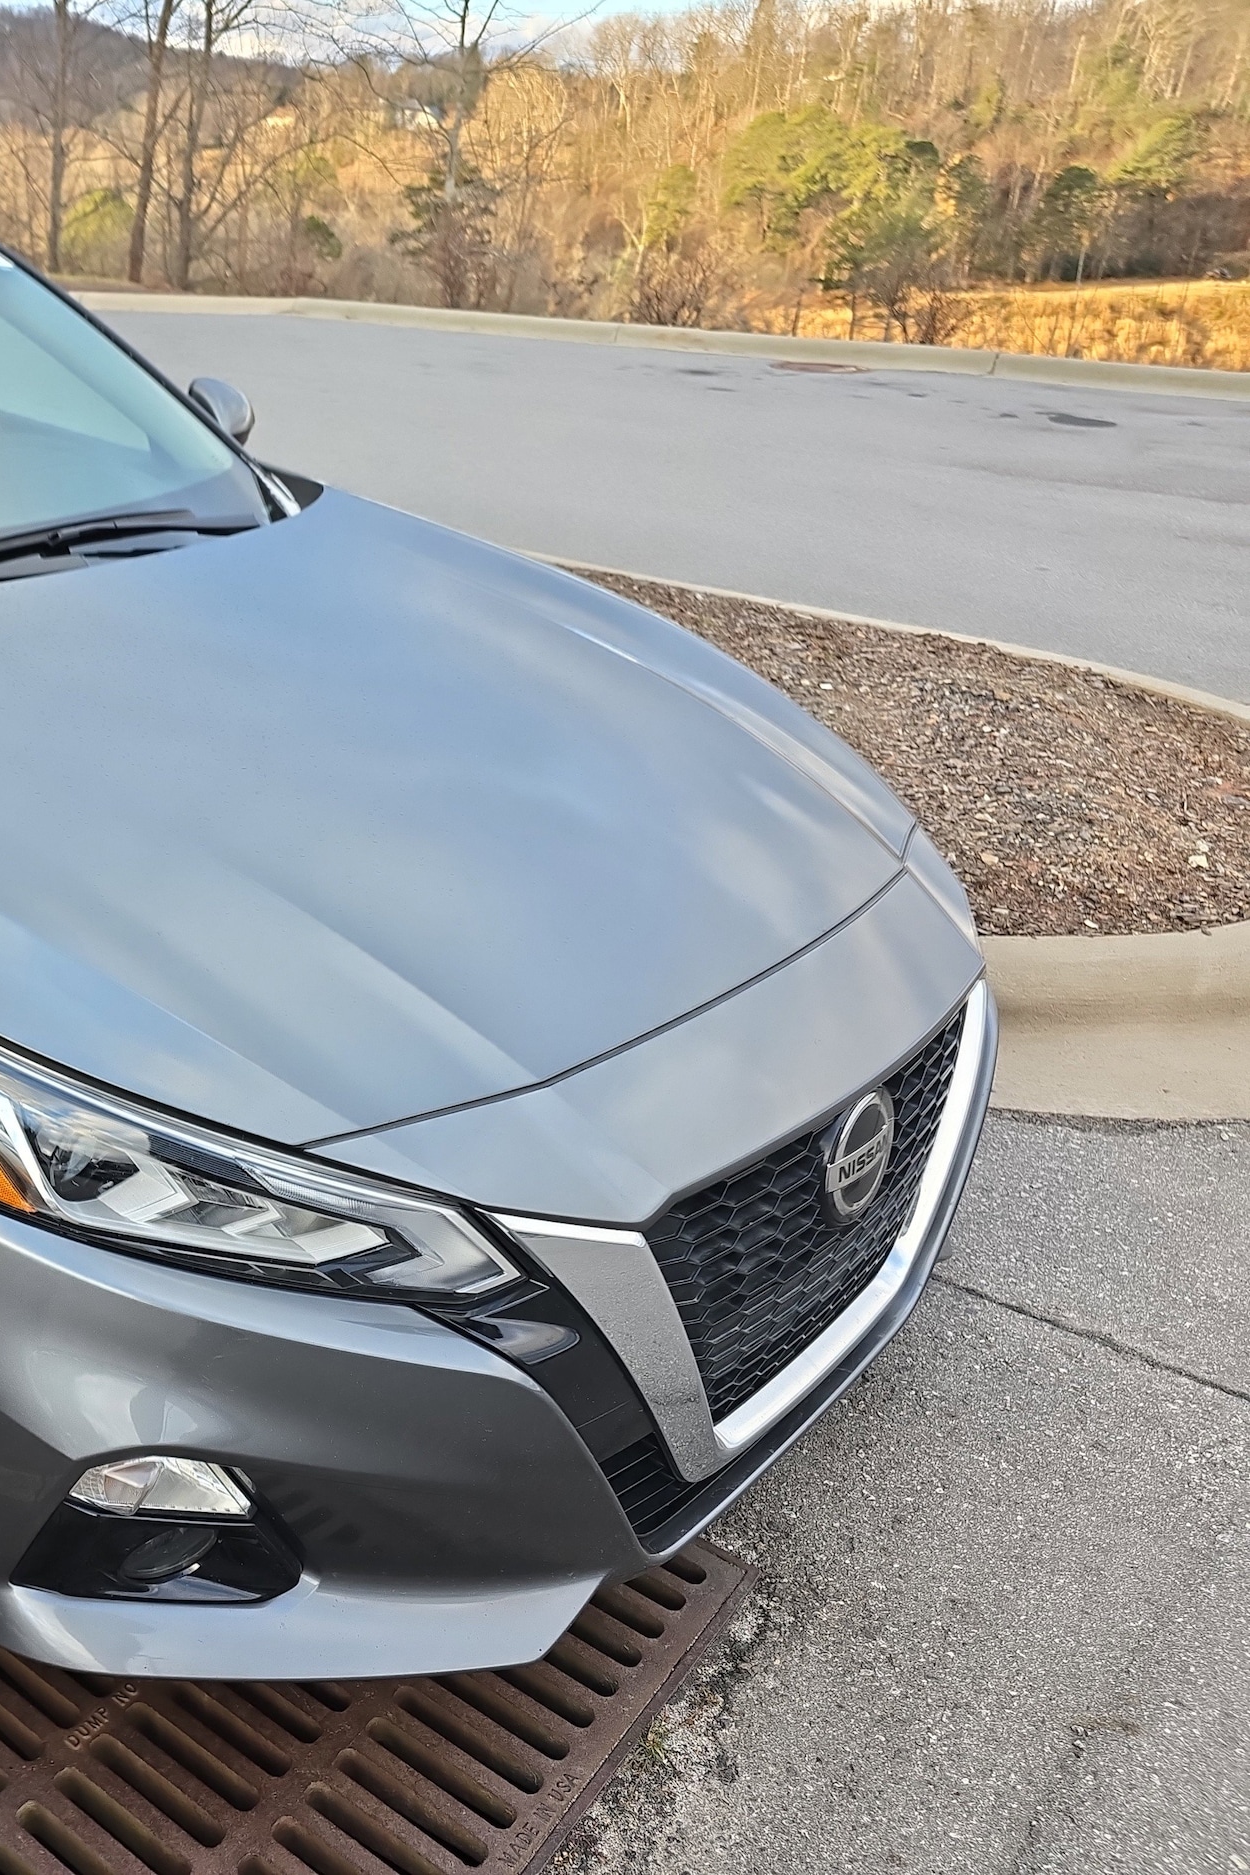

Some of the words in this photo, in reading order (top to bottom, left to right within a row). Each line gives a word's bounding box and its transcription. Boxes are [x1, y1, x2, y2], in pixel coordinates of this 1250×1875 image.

[838, 1135, 888, 1183] NISSAN
[64, 1706, 109, 1751] DUMP
[111, 1682, 139, 1707] NO
[497, 1821, 540, 1869] MADE
[533, 1802, 557, 1824] IN
[548, 1773, 580, 1801] USA
